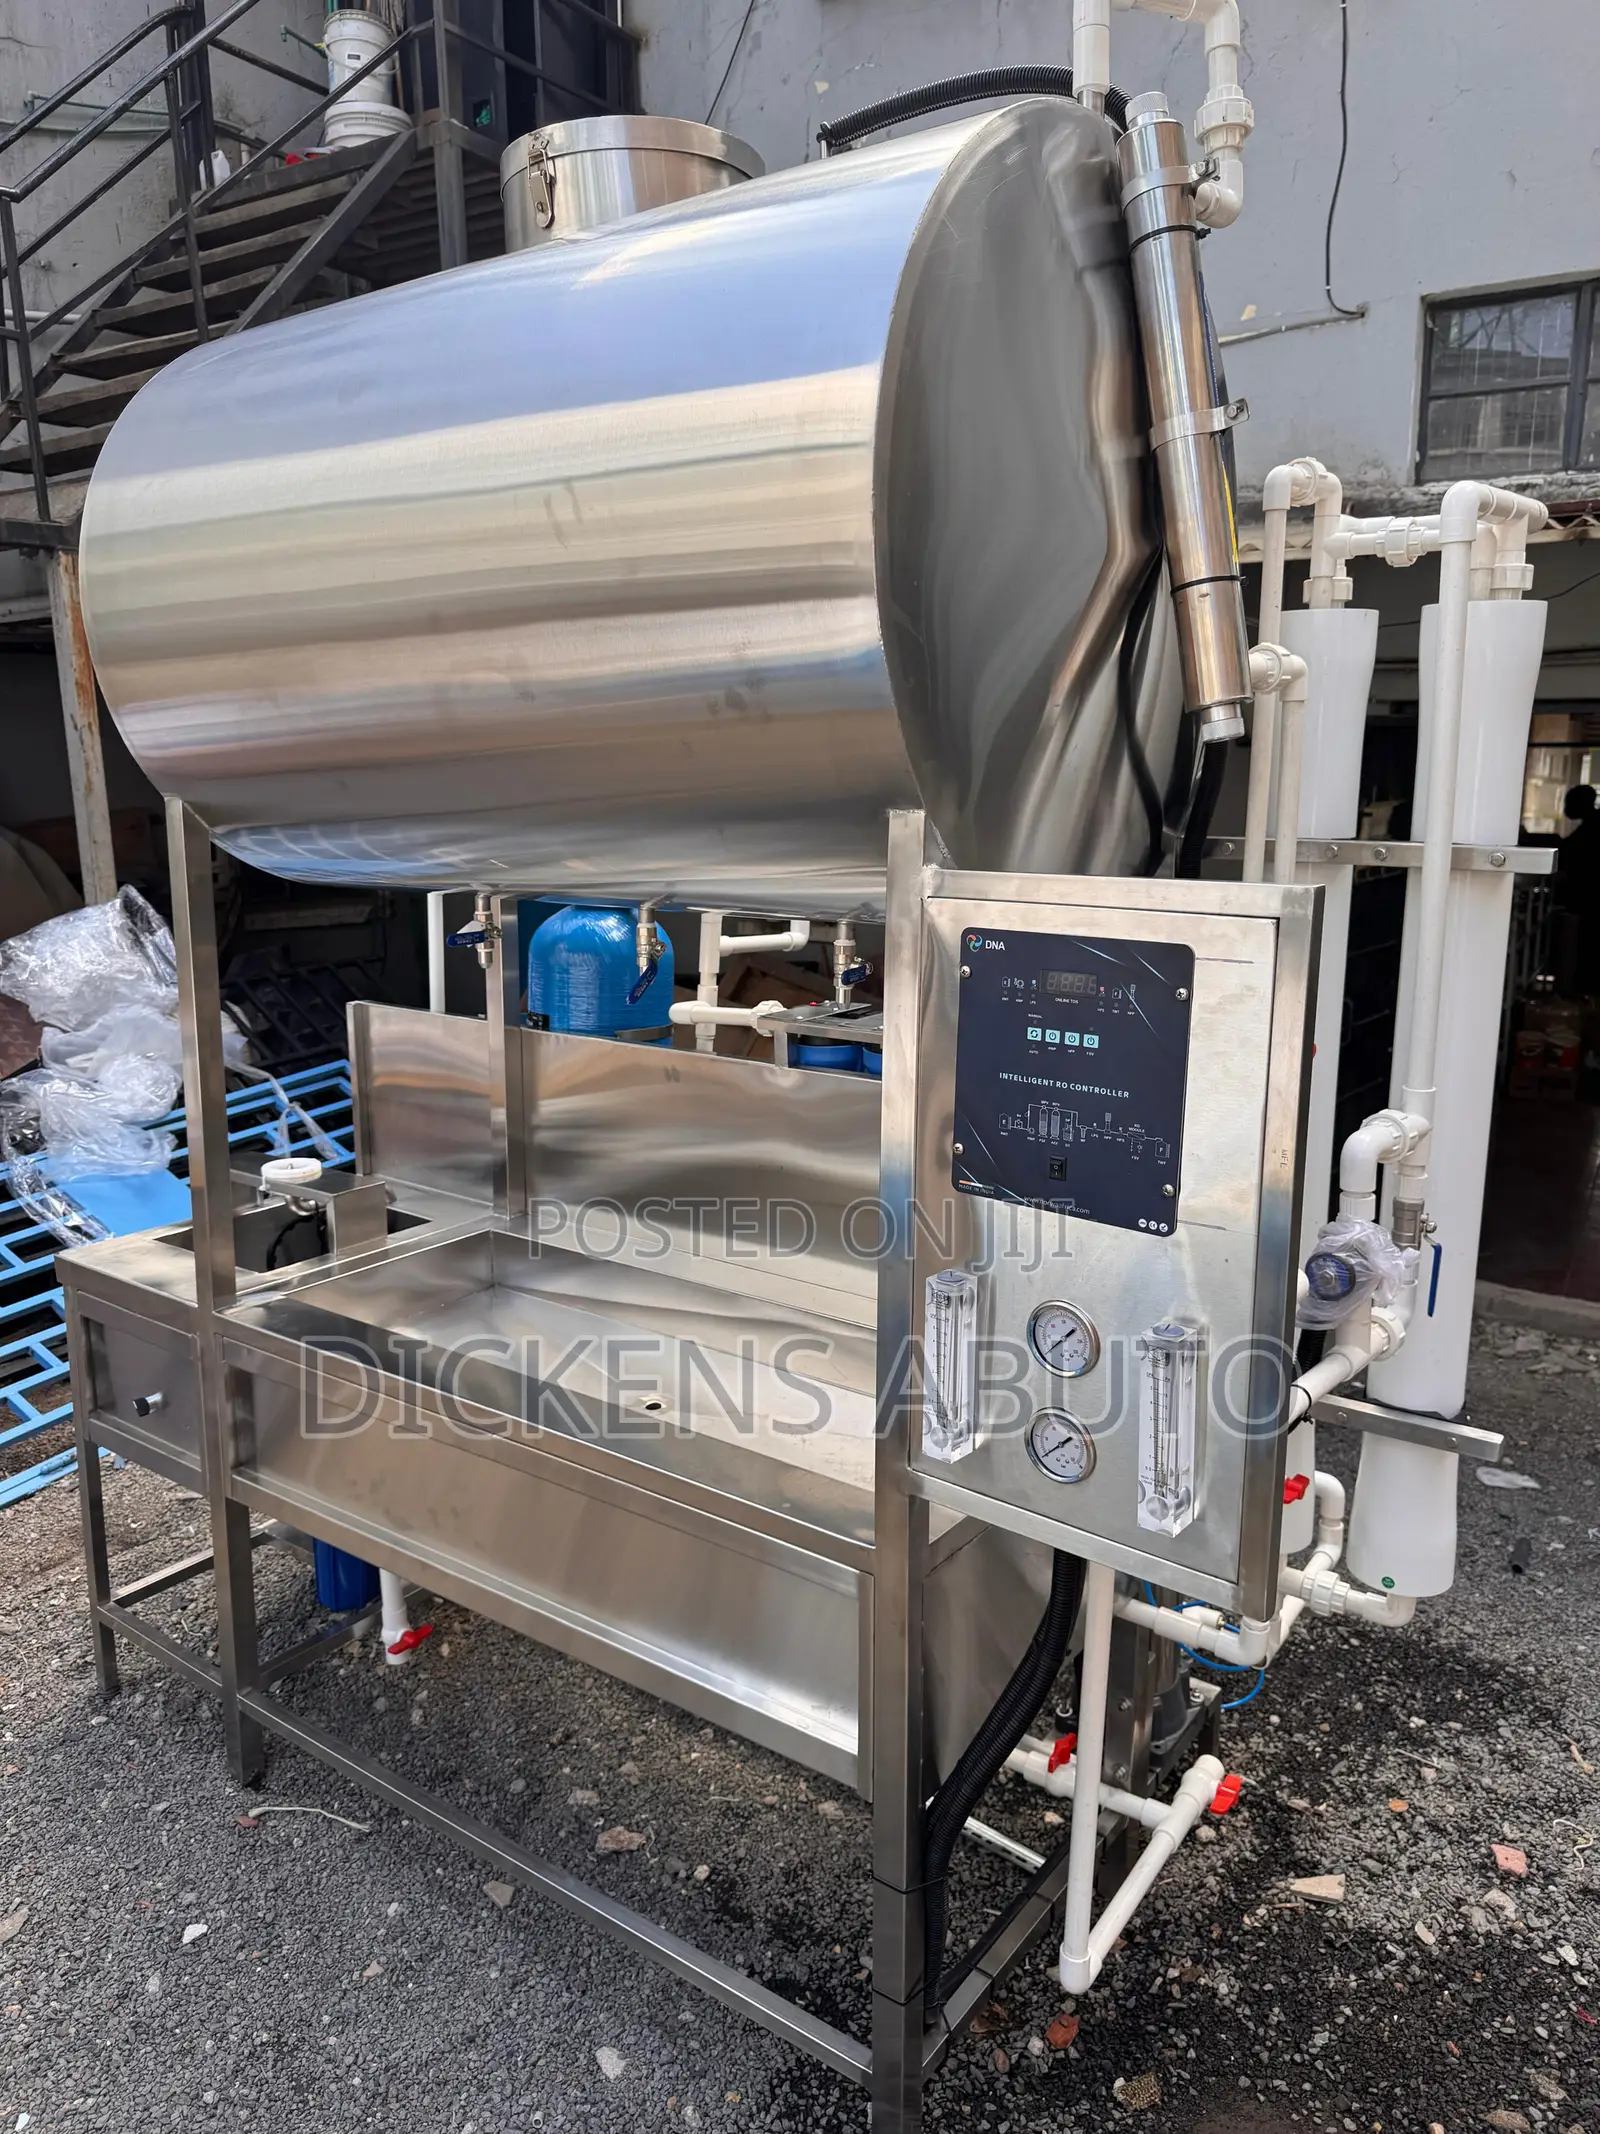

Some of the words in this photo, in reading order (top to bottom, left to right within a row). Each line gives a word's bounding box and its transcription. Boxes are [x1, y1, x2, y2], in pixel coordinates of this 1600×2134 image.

[985, 940, 1006, 951] DNA
[999, 1072, 1054, 1088] INTELLIGENT
[1056, 1081, 1068, 1089] RO
[1069, 1083, 1130, 1099] CONTROLLER
